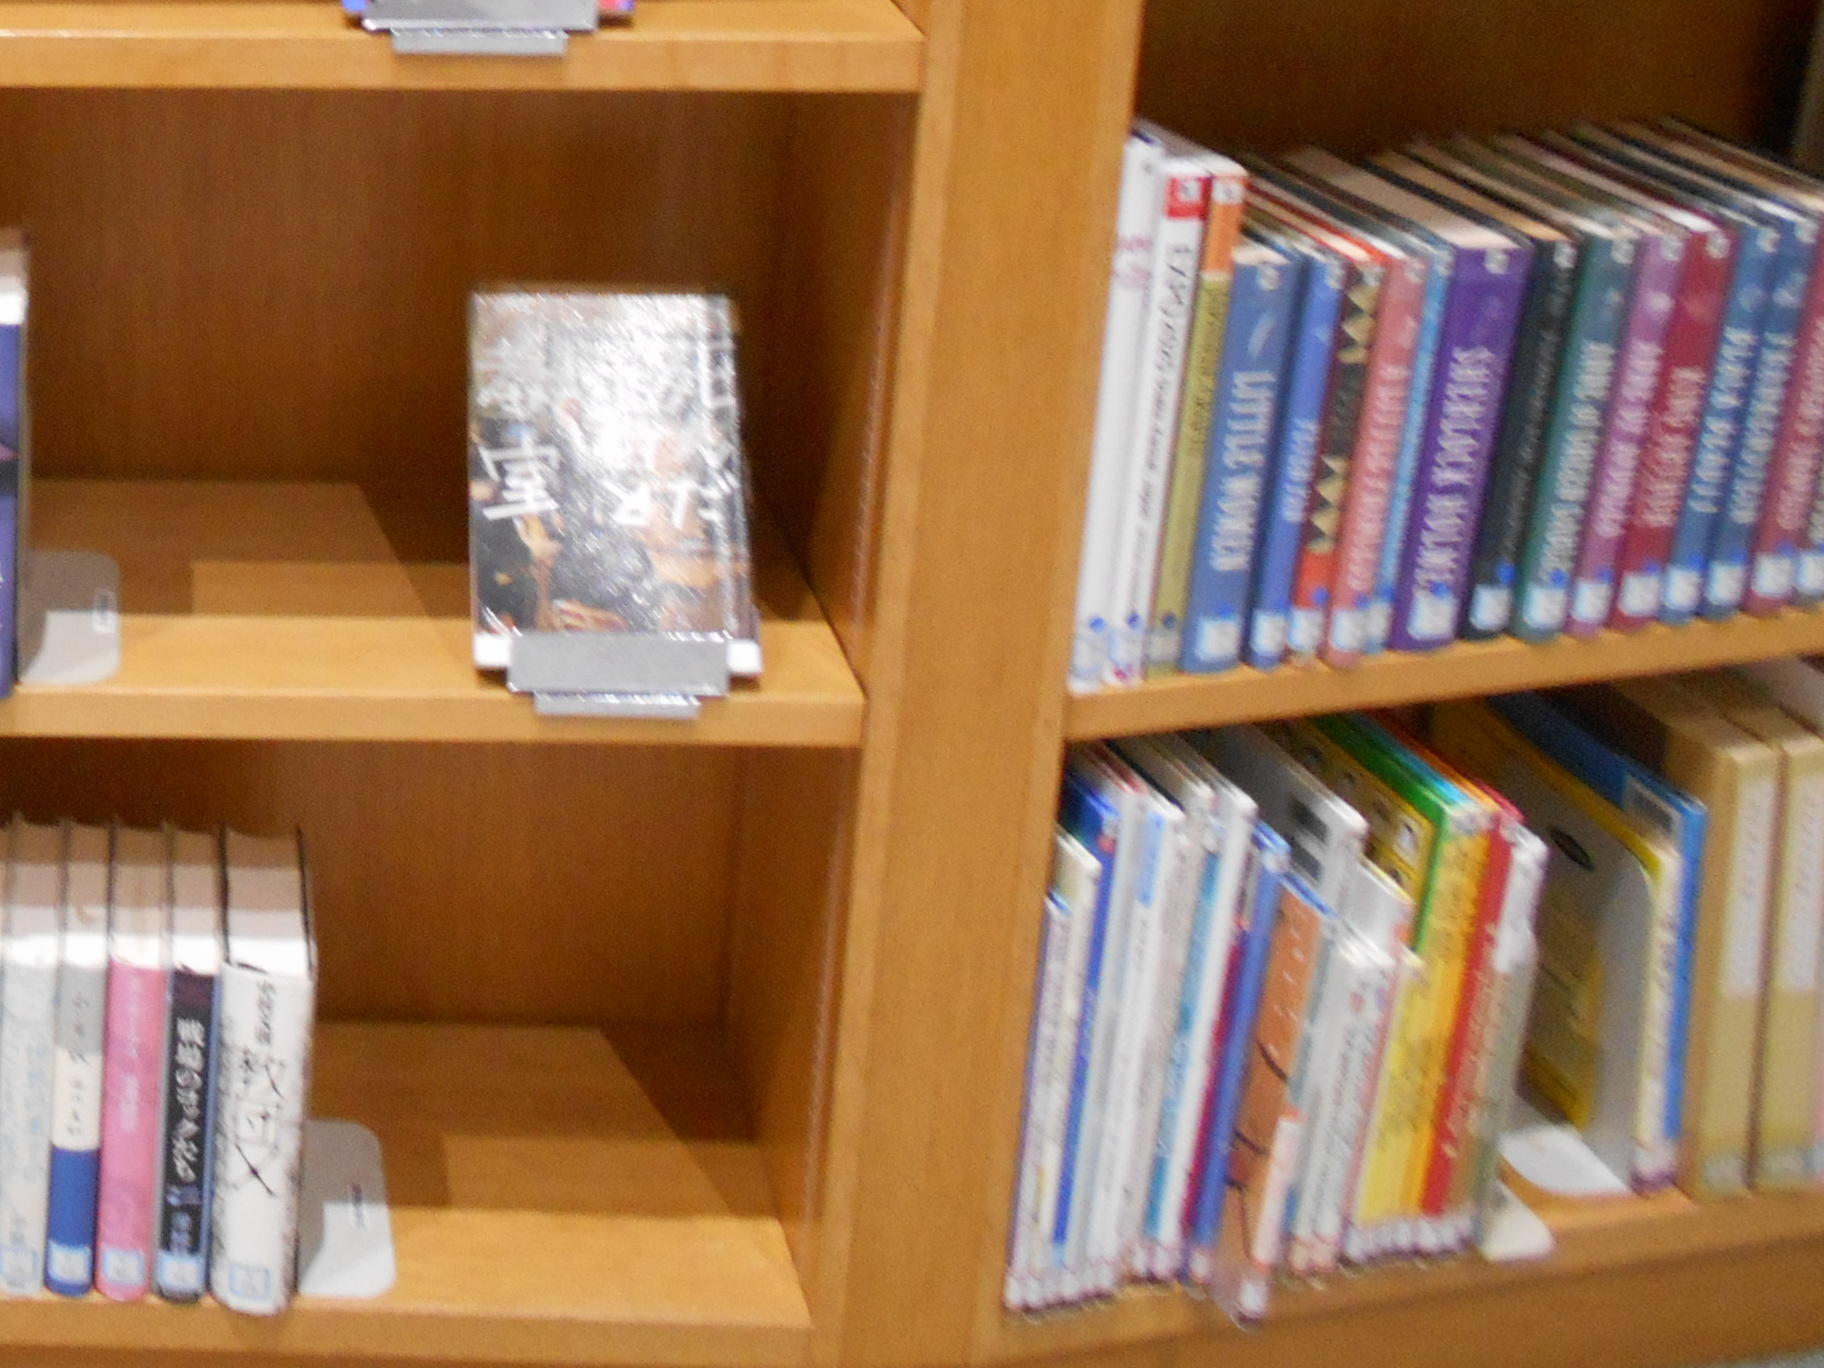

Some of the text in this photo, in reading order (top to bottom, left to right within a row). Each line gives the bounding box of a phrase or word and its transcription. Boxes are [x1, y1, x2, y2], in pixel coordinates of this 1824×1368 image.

[1212, 373, 1275, 572] LITTLE WOMEN
[1432, 346, 1491, 487] SHERLOCK
[1690, 329, 1755, 515] BLACK BEAUTY
